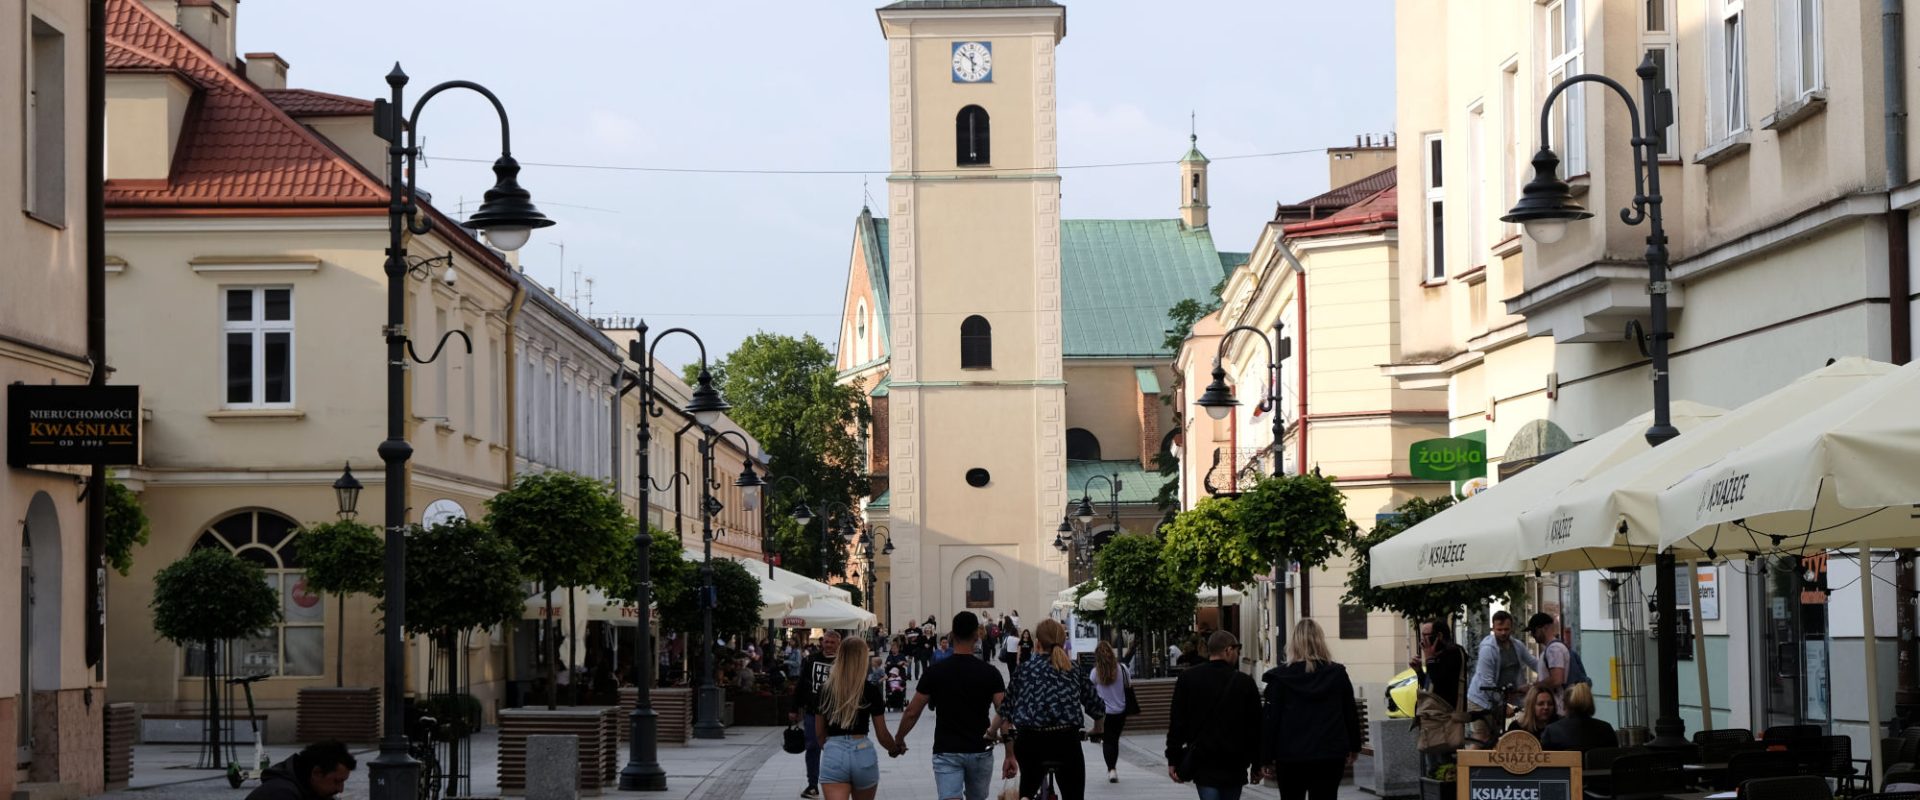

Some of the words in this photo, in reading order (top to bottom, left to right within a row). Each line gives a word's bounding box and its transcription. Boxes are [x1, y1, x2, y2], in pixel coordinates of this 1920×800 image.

[30, 408, 132, 419] NIERUCHOMOŚCI
[30, 421, 132, 437] KWAŚNIAK
[1418, 447, 1481, 464] żabka
[1428, 540, 1467, 567] KSIĄŻĘCE
[619, 607, 657, 618] TYSIE
